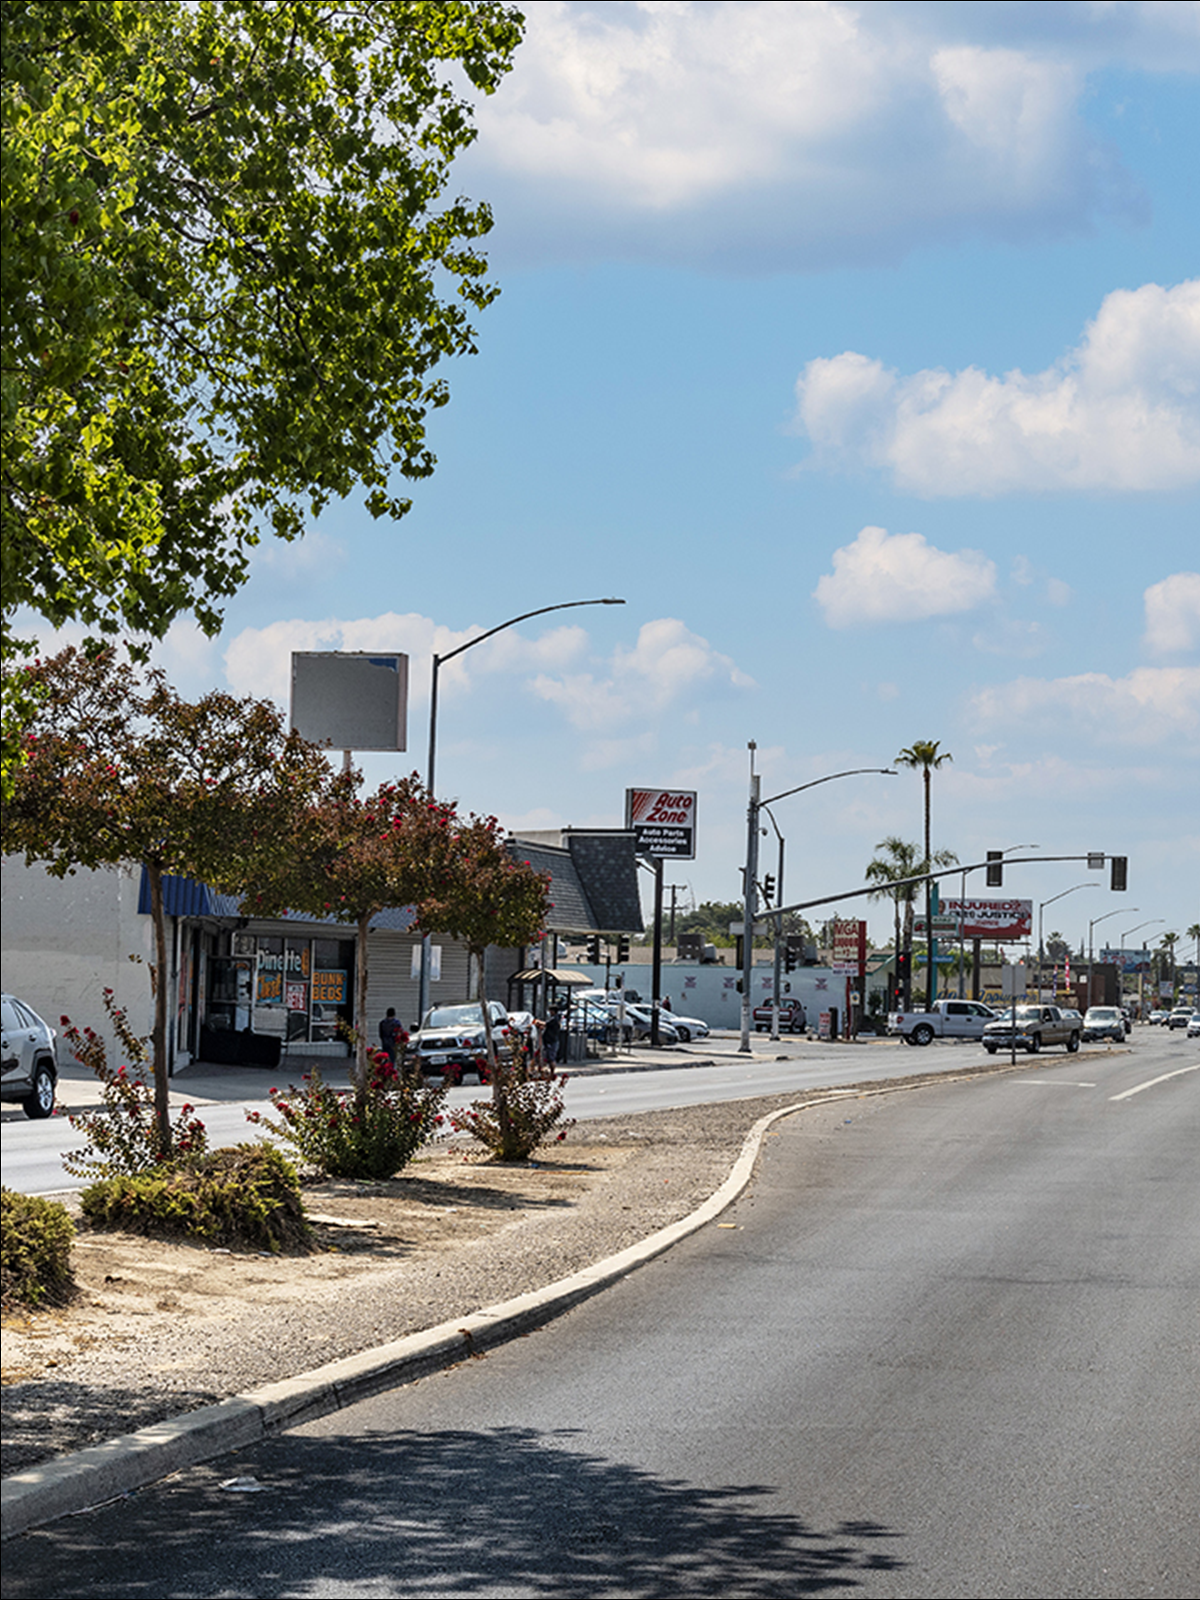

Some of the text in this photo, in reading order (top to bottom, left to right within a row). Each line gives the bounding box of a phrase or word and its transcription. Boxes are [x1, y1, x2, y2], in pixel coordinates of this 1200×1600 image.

[655, 793, 692, 808] Auto
[645, 807, 688, 823] Zone
[638, 836, 687, 845] Accessories
[312, 986, 343, 1001] BEDS
